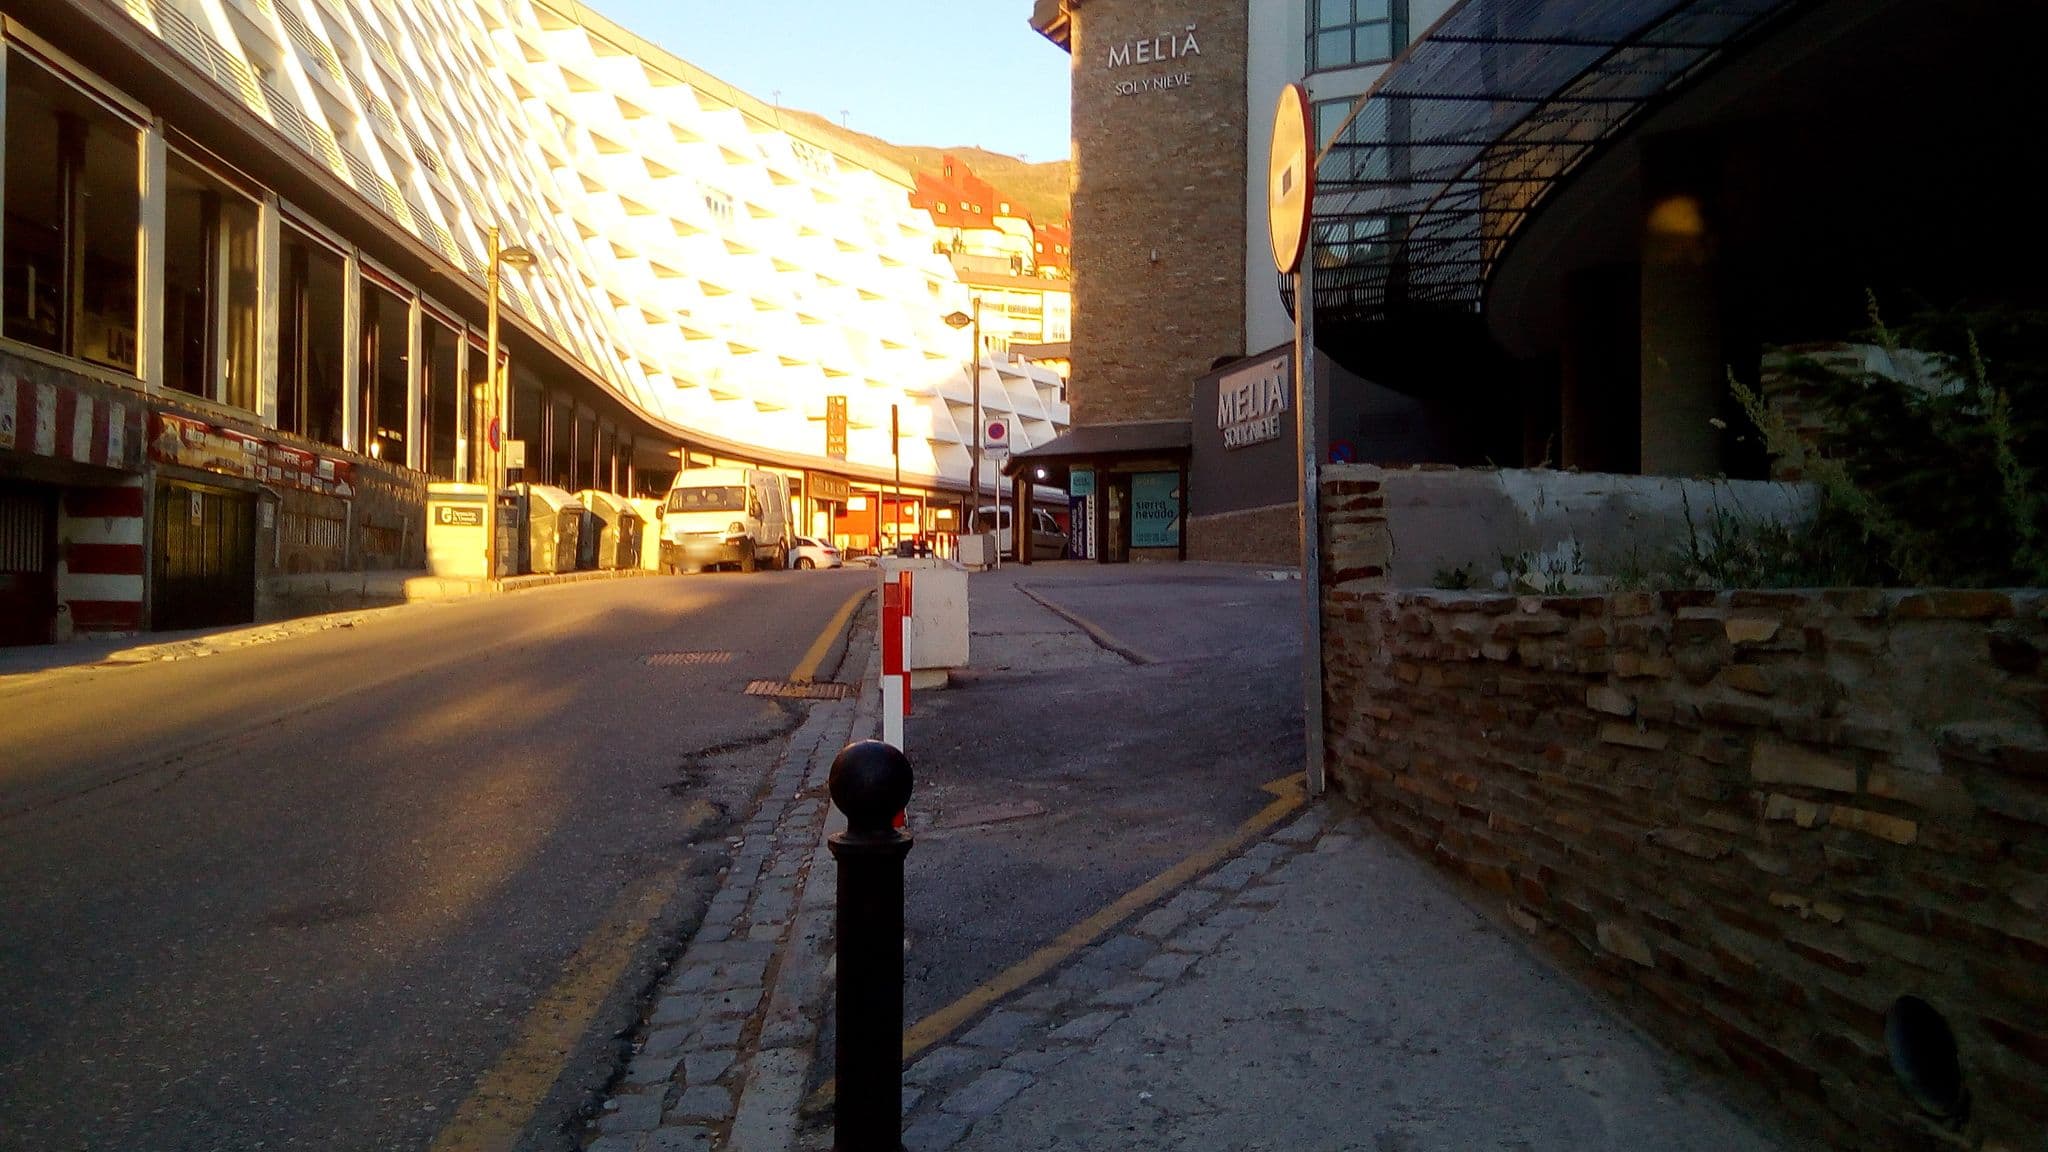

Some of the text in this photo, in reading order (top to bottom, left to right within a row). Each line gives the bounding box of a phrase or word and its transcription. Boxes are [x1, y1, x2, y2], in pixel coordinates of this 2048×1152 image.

[1115, 71, 1192, 97] SOL Y NIEVE
[1136, 510, 1174, 520] nevada
